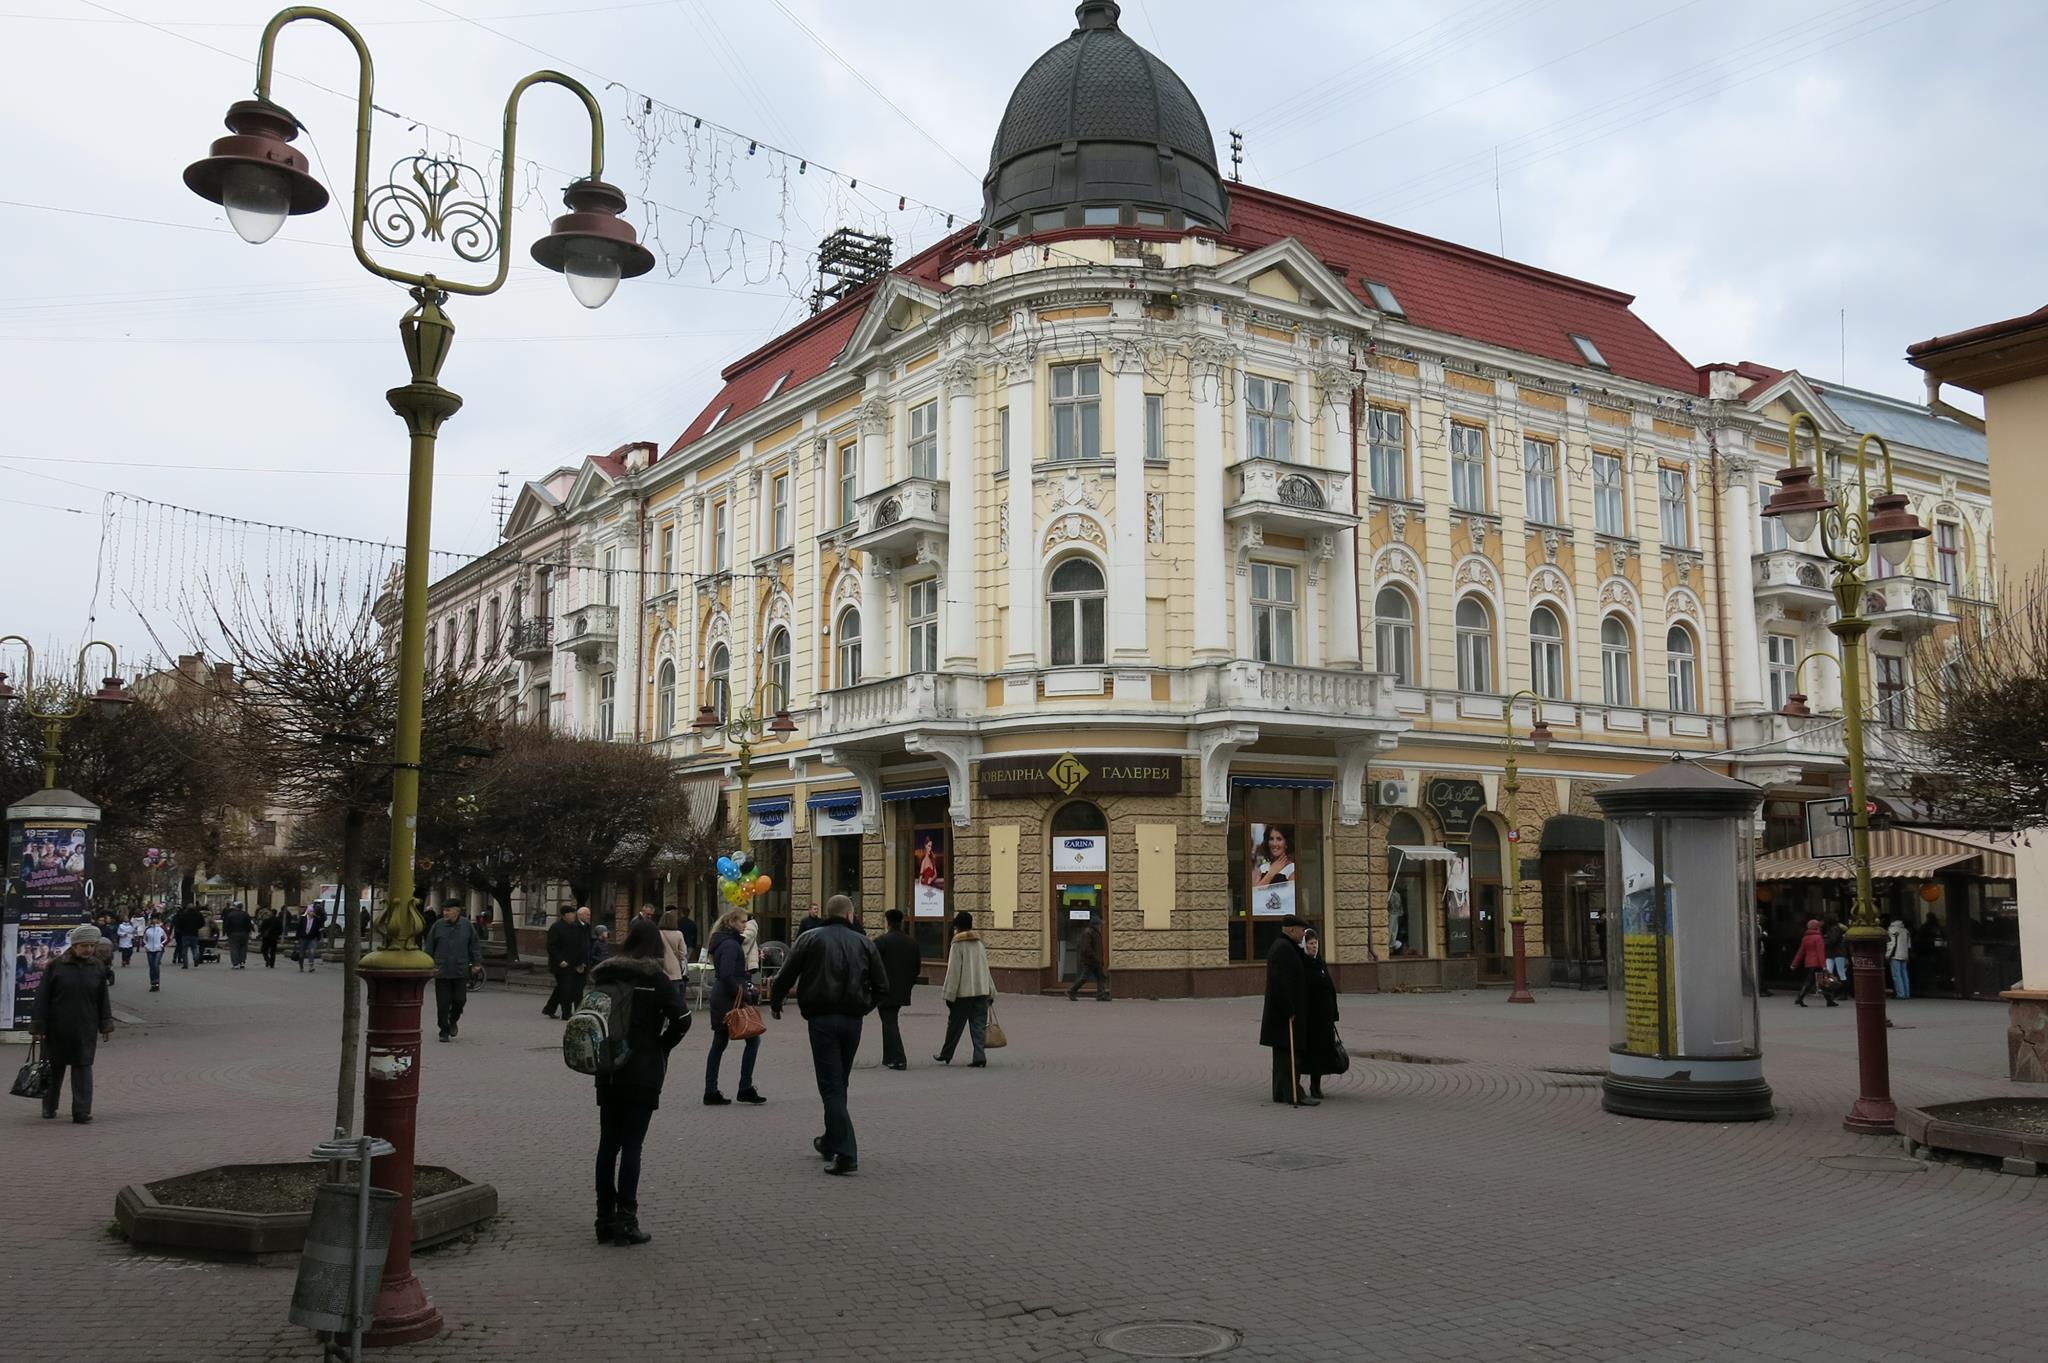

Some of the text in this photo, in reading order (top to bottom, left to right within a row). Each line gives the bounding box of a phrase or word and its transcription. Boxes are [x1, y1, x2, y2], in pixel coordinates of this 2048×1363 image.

[981, 768, 1044, 783] ЮВЕЛІРНА
[1102, 766, 1170, 780] ГАЛЕРЕЯ
[1064, 840, 1094, 848] ZARINA
